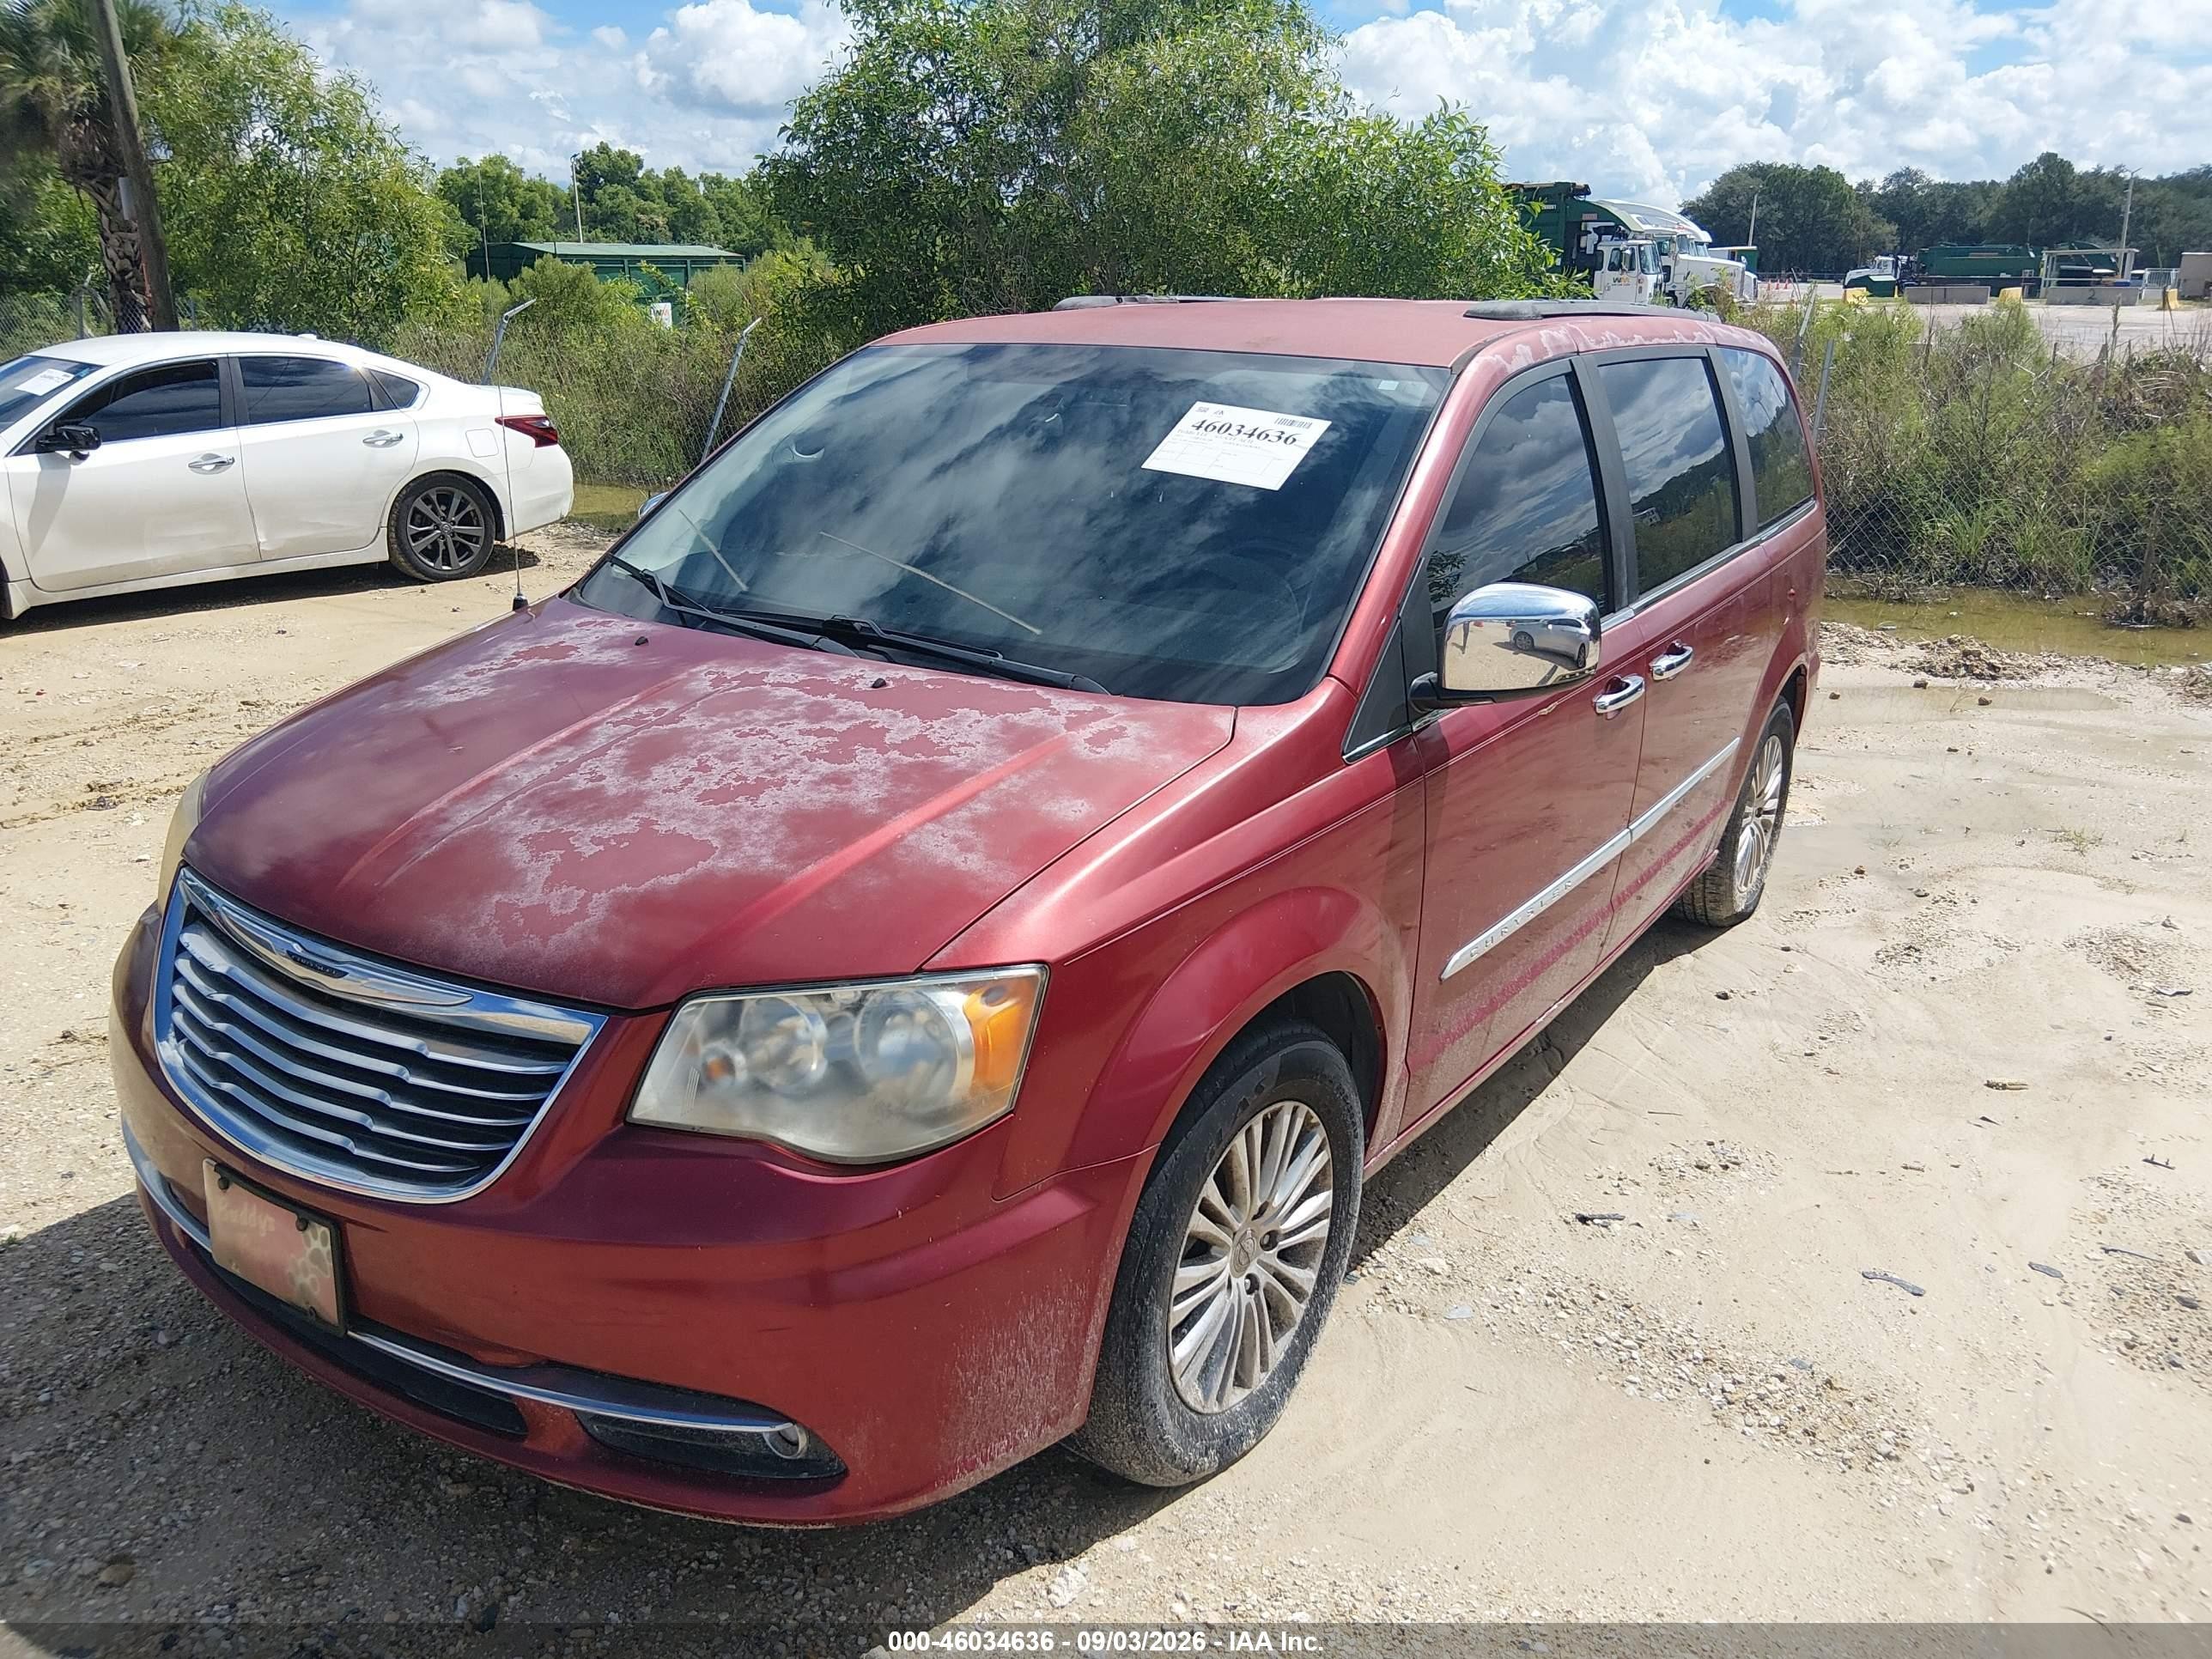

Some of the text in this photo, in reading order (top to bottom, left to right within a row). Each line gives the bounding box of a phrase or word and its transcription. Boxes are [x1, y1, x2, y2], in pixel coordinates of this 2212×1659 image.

[2087, 288, 2097, 301] 2
[1191, 419, 1303, 446] 46034636
[1469, 880, 1572, 958] CHRYSLER
